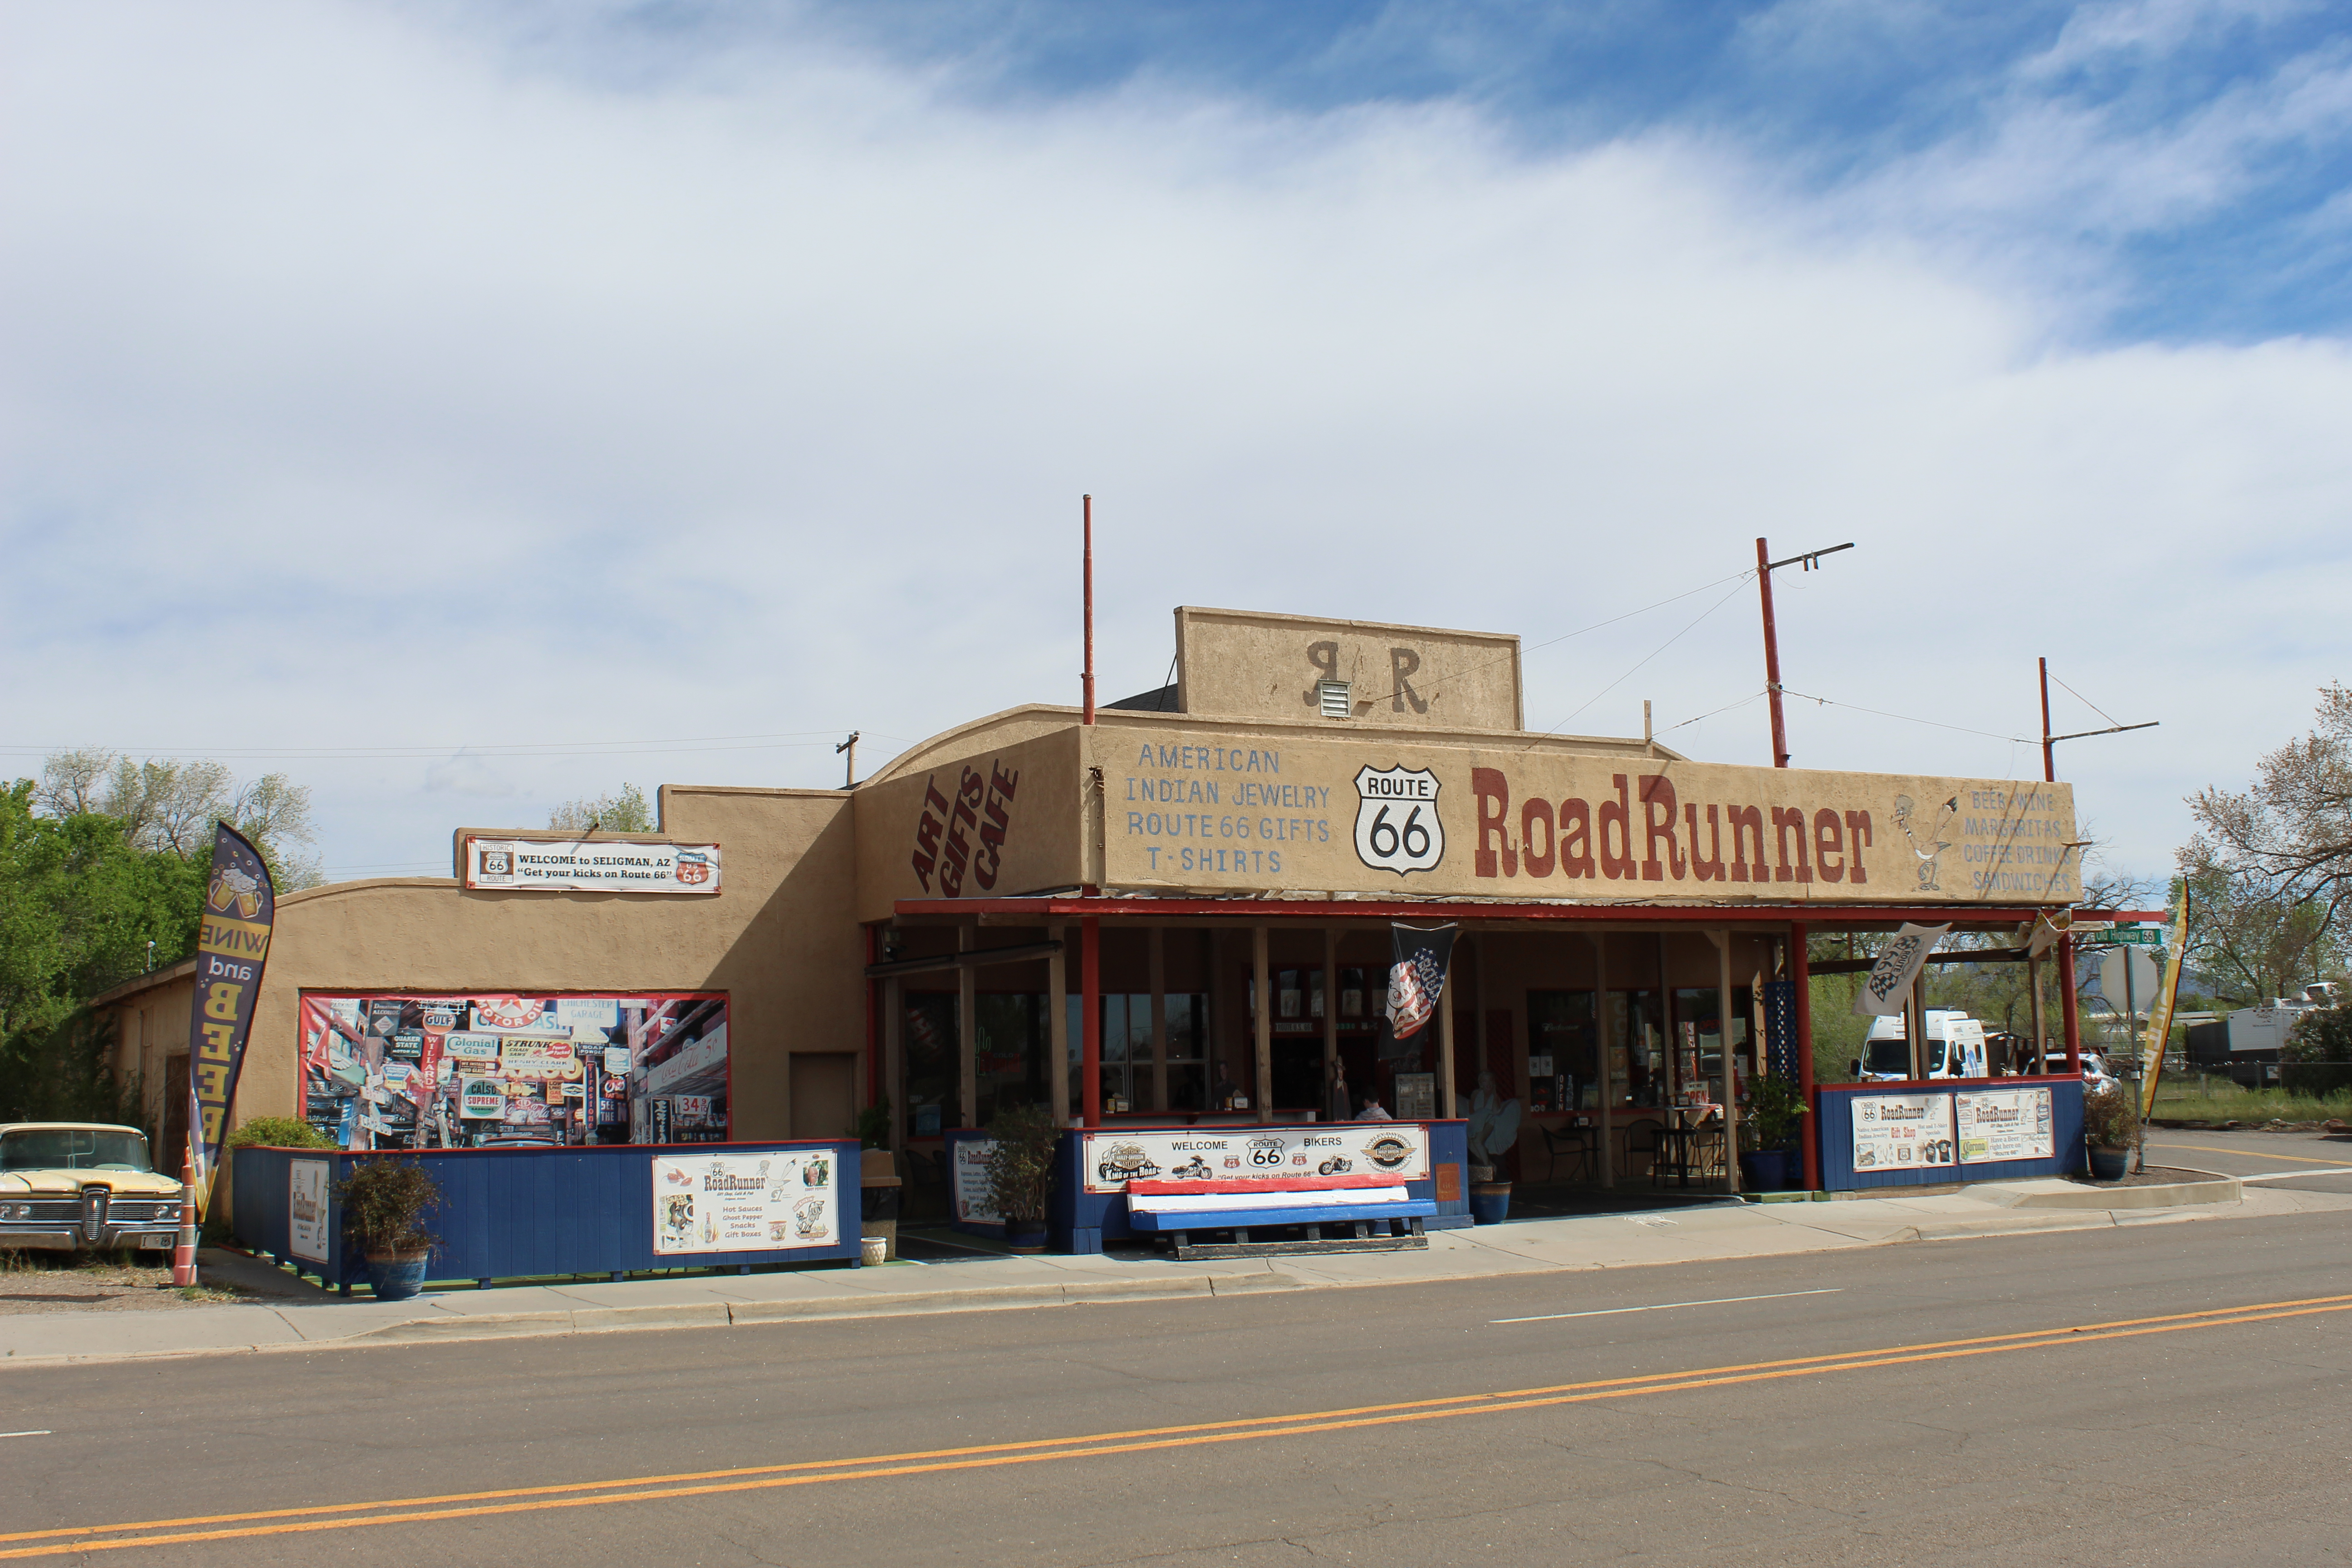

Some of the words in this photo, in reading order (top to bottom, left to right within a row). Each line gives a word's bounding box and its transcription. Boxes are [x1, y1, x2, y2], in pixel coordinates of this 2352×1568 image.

[1391, 647, 1427, 714] R
[1138, 743, 1279, 773] AMERICAN
[1127, 777, 1219, 804] INDIAN
[1231, 783, 1330, 808] JEWELRY
[1368, 777, 1429, 797] ROUTE
[940, 764, 984, 898] GIFTS
[974, 758, 1019, 891] CAFE
[1128, 811, 1213, 838] ROUTE
[1220, 815, 1250, 839] 66
[1259, 819, 1329, 843] GIFTS
[1370, 805, 1430, 858] 66
[1472, 768, 1872, 883] RoadRunner
[1965, 818, 2061, 837] MARGARITAS
[912, 774, 949, 894] ART
[519, 855, 576, 864] WELCOME
[593, 857, 653, 867] SELIGMAN,
[1147, 846, 1281, 874] T-SHIRTS
[1964, 844, 2013, 863] COFFEE
[2017, 845, 2071, 865] DRINKS
[490, 860, 504, 870] 66
[546, 869, 571, 878] your
[573, 869, 601, 877] kicks
[621, 870, 651, 878] Route
[683, 869, 701, 882] 66
[1974, 871, 2070, 892] SANDWICHES
[2111, 930, 2140, 943] Highway
[2143, 931, 2153, 941] 66
[1877, 951, 1899, 971] 66
[1893, 950, 1911, 973] ROUTE
[426, 1015, 454, 1026] GULF
[477, 1000, 524, 1026] MOTOR
[527, 1001, 544, 1019] OIL
[571, 1009, 604, 1019] GARAGE
[447, 1036, 495, 1051] Colonial
[506, 1040, 552, 1048] STRUNK
[424, 1037, 438, 1085] WILLARD
[471, 1081, 497, 1094] CALSO
[468, 1096, 499, 1105] SUPREME
[600, 1100, 614, 1110] SEE
[601, 1112, 614, 1122] THE
[1864, 1109, 1875, 1119] 66
[1880, 1104, 1924, 1121] RoadRunner
[1976, 1106, 2019, 1123] RoadRunner
[1891, 1127, 1901, 1139] Gift
[1903, 1126, 1916, 1140] Shop
[1172, 1141, 1228, 1151] WELCOME
[1304, 1137, 1342, 1147] BIKERS
[959, 1152, 966, 1162] 66
[1253, 1149, 1280, 1165] 66
[713, 1167, 723, 1176] 66
[1106, 1169, 1123, 1181] KING
[1139, 1166, 1156, 1176] ROAD
[704, 1174, 766, 1191] RoadRunner
